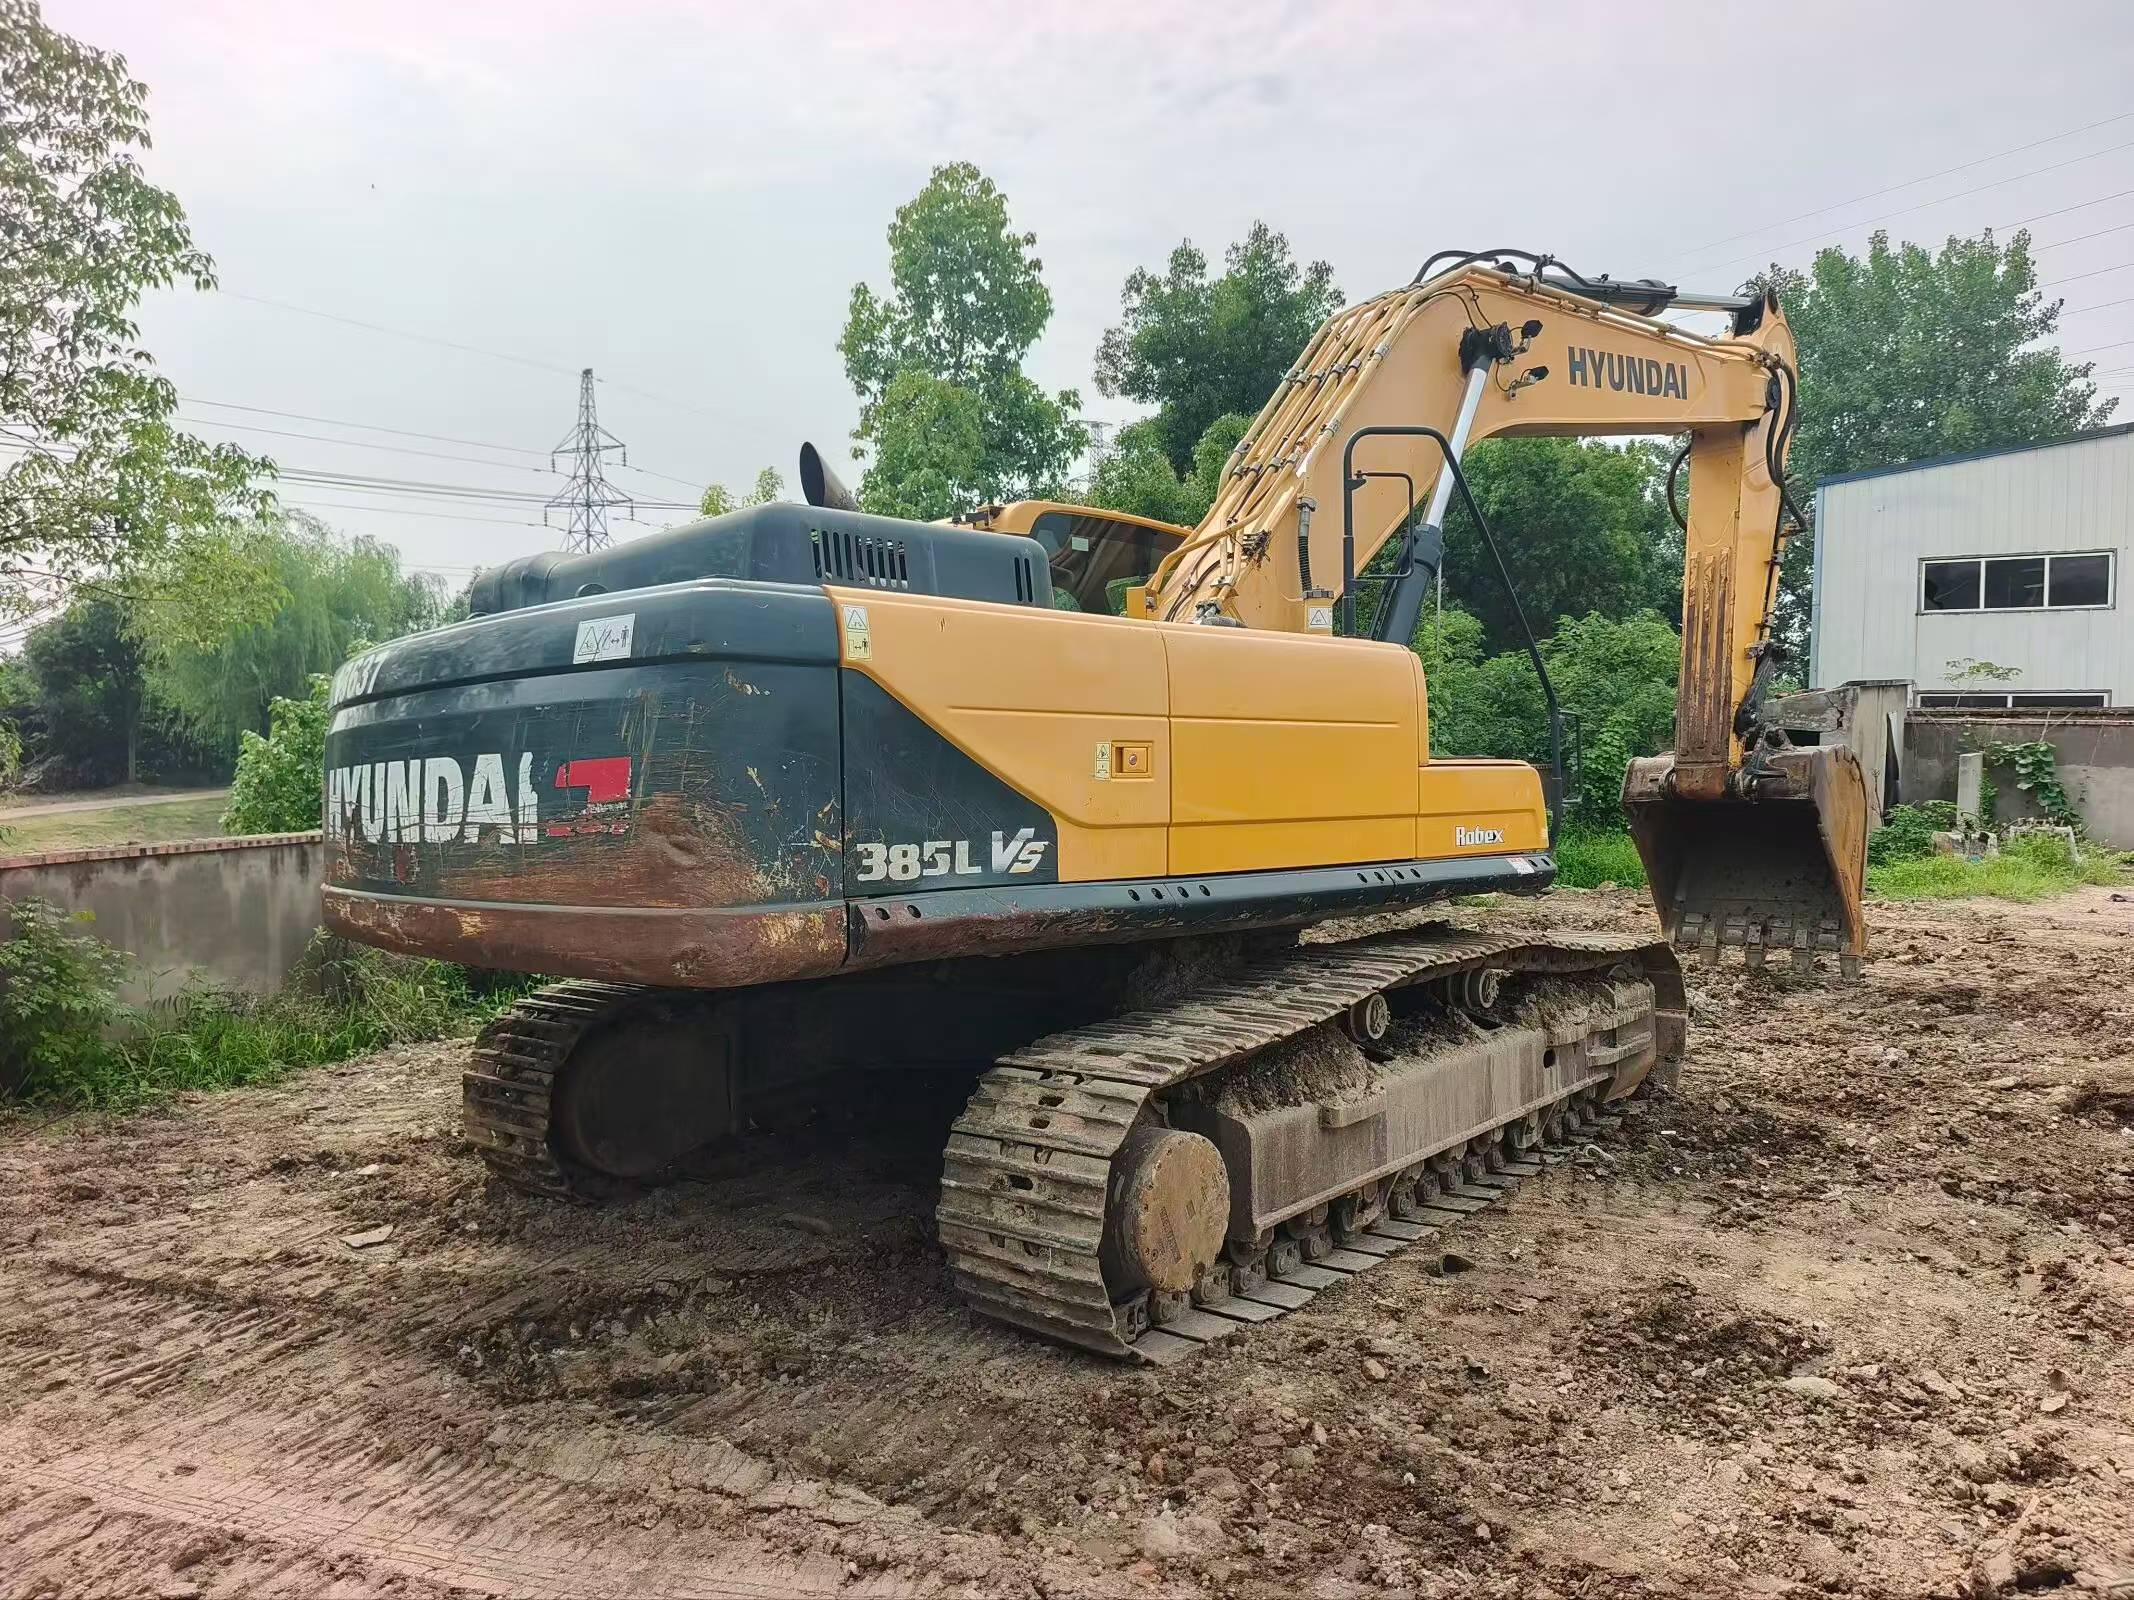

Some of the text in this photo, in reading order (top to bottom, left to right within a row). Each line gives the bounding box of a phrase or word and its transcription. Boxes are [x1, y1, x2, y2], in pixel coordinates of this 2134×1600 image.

[1568, 345, 1688, 401] HYUNDAI
[328, 752, 538, 844] HYUNDAI
[1456, 826, 1504, 846] Robex
[857, 840, 982, 881] 385L
